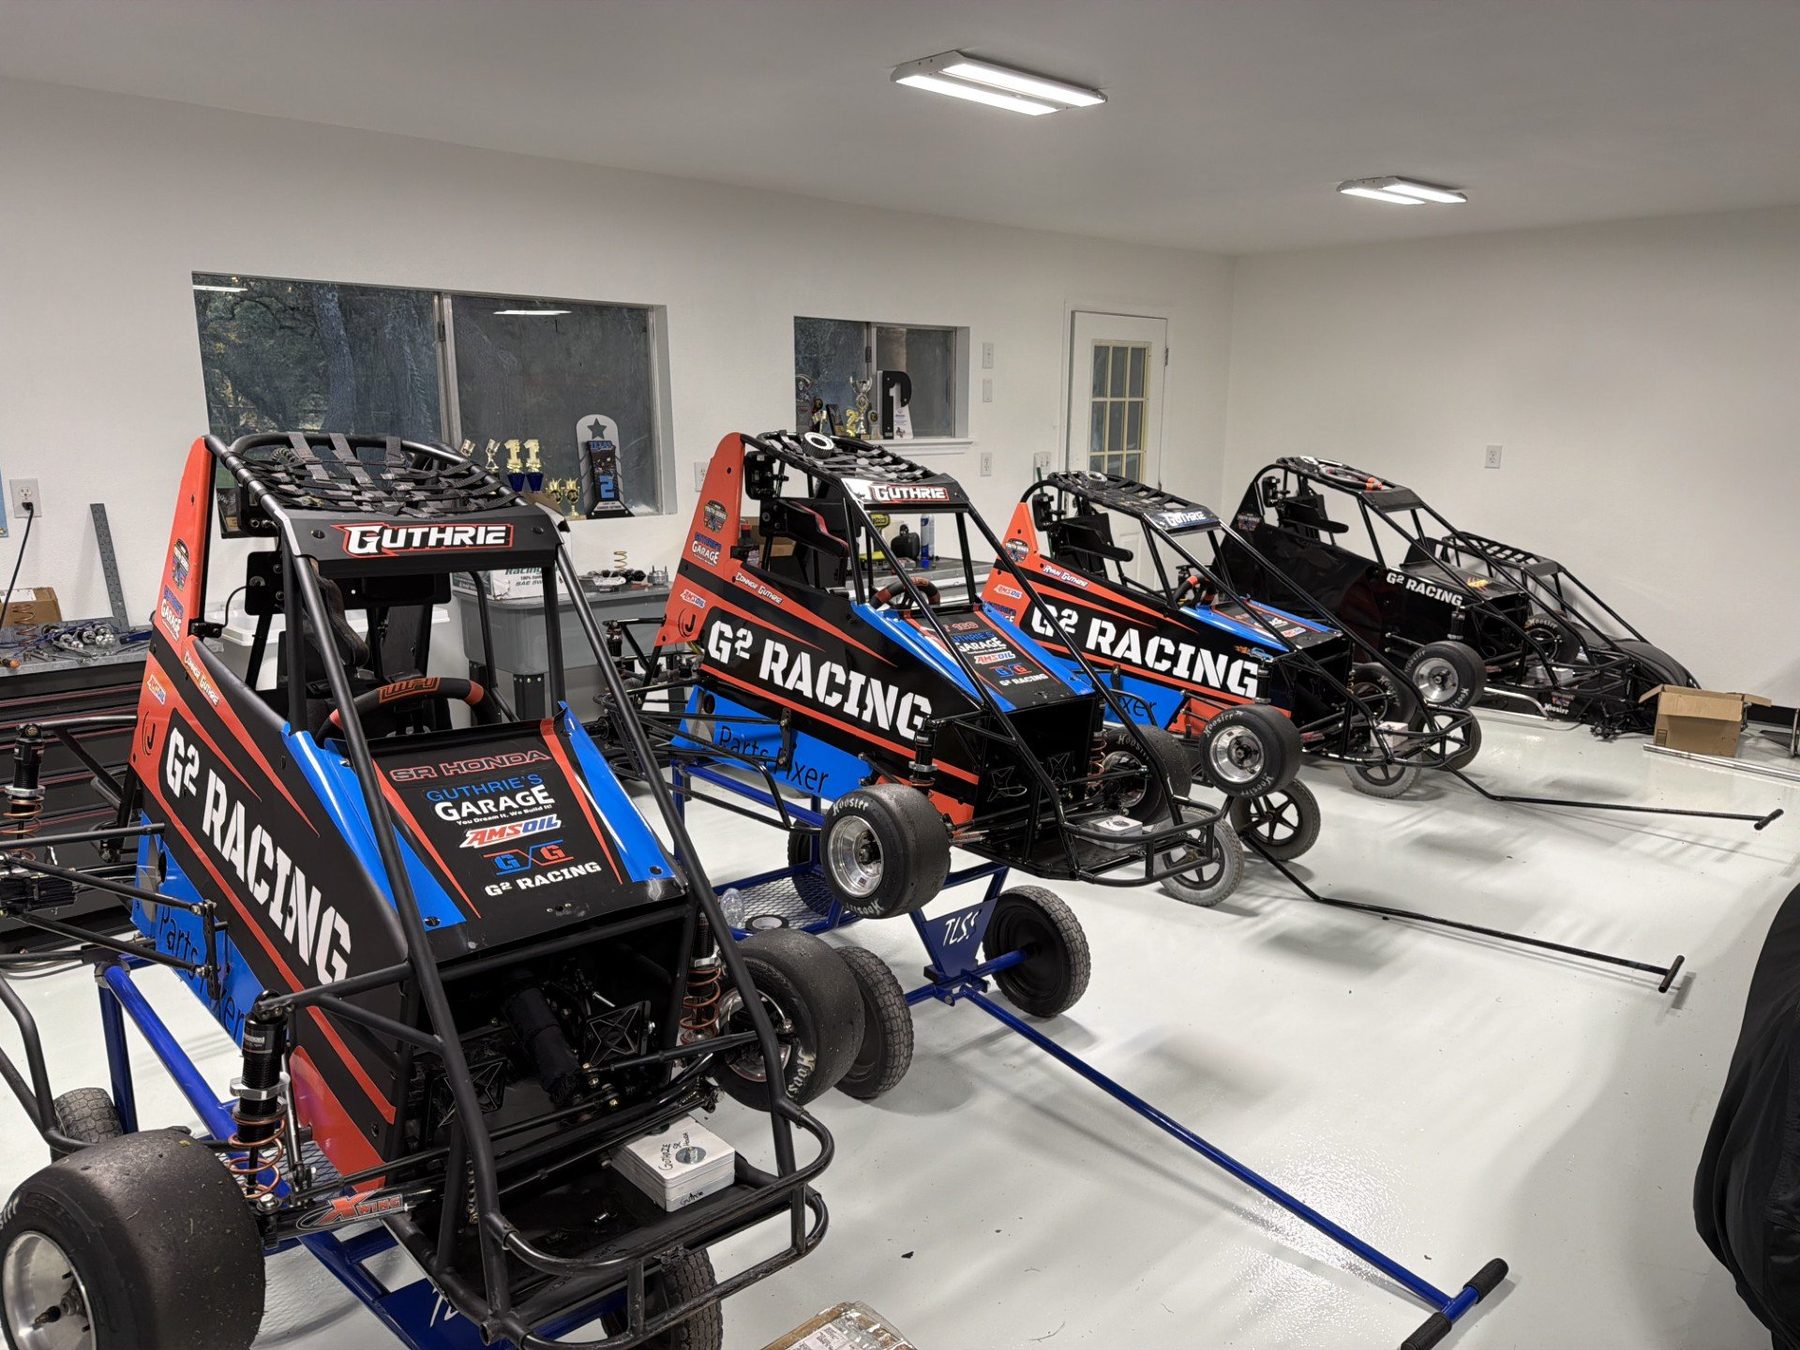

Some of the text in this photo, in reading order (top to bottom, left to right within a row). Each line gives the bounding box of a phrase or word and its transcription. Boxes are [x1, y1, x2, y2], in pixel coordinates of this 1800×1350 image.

[599, 475, 615, 499] 2
[344, 525, 506, 554] GUTHRIE
[1405, 579, 1463, 606] RACING
[1086, 617, 1259, 698] RACING
[759, 638, 932, 740] RACING
[390, 750, 552, 782] SR HONDA
[426, 774, 544, 801] GUTHRIE'S
[434, 784, 556, 821] GARAGE
[473, 814, 500, 823] Dream
[523, 805, 544, 814] Build
[463, 815, 560, 847] AMSOIL
[202, 768, 351, 985] RACING
[516, 861, 602, 890] RACING
